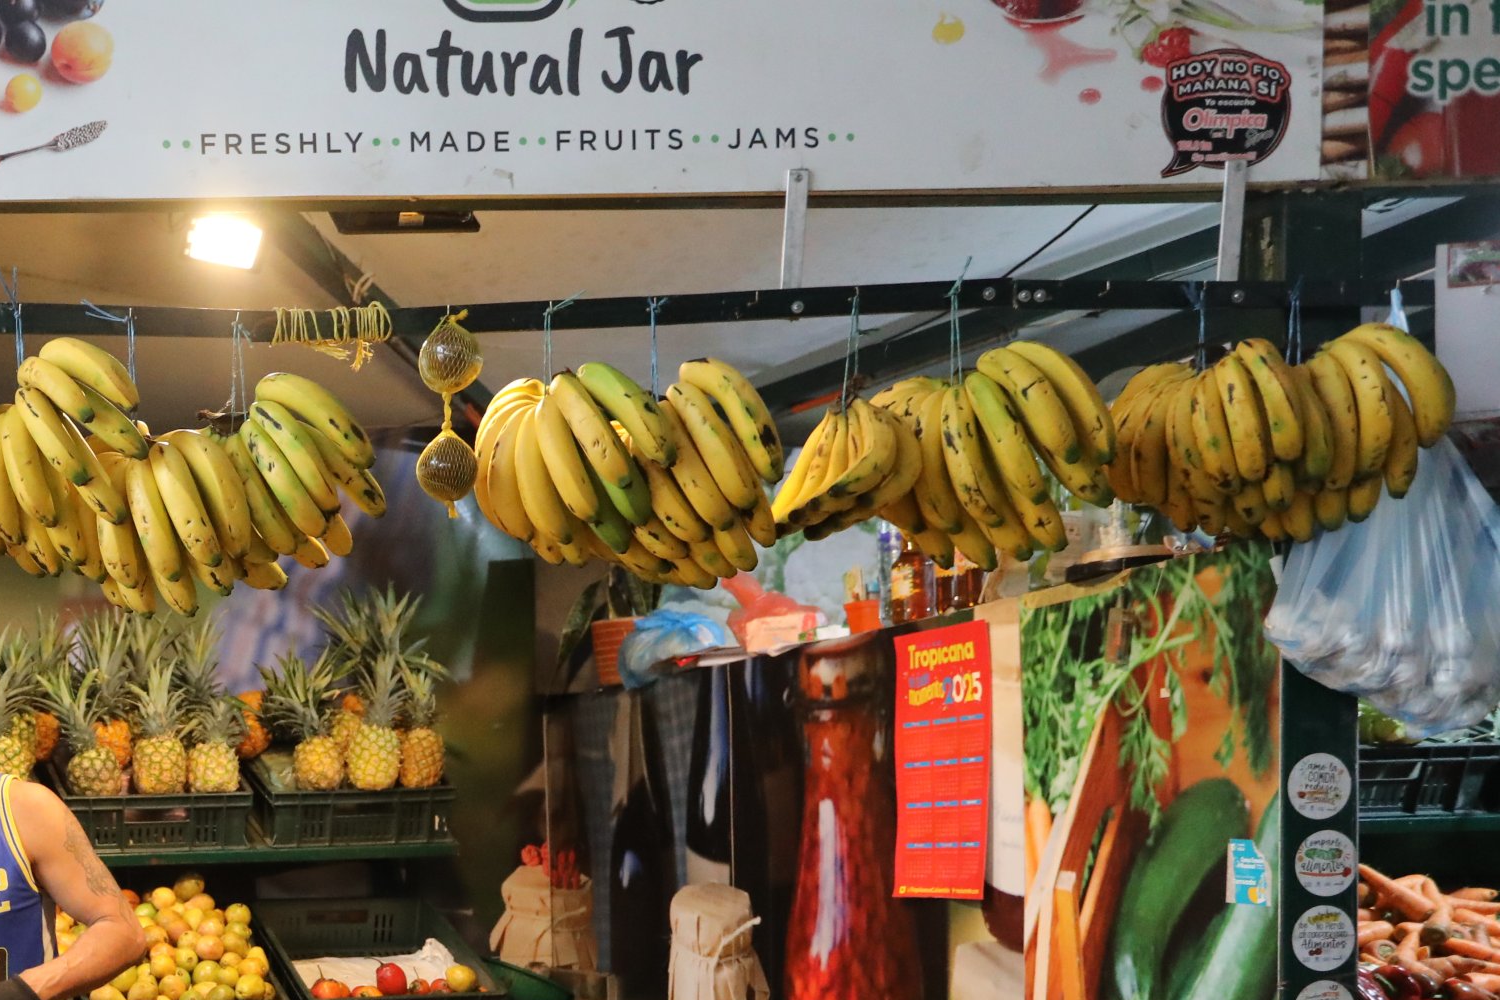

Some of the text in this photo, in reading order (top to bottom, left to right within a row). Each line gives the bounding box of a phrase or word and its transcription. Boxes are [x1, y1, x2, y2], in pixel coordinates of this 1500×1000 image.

[1425, 0, 1470, 37] in
[345, 26, 703, 97] Natural Jar
[1172, 60, 1284, 83] HOY NO FIO,
[1178, 77, 1277, 97] MAÑANA SÍ
[202, 127, 818, 153] FRESHLY MADE FRUITS JAMS
[907, 640, 975, 671] Tropicana
[941, 671, 983, 705] 2025
